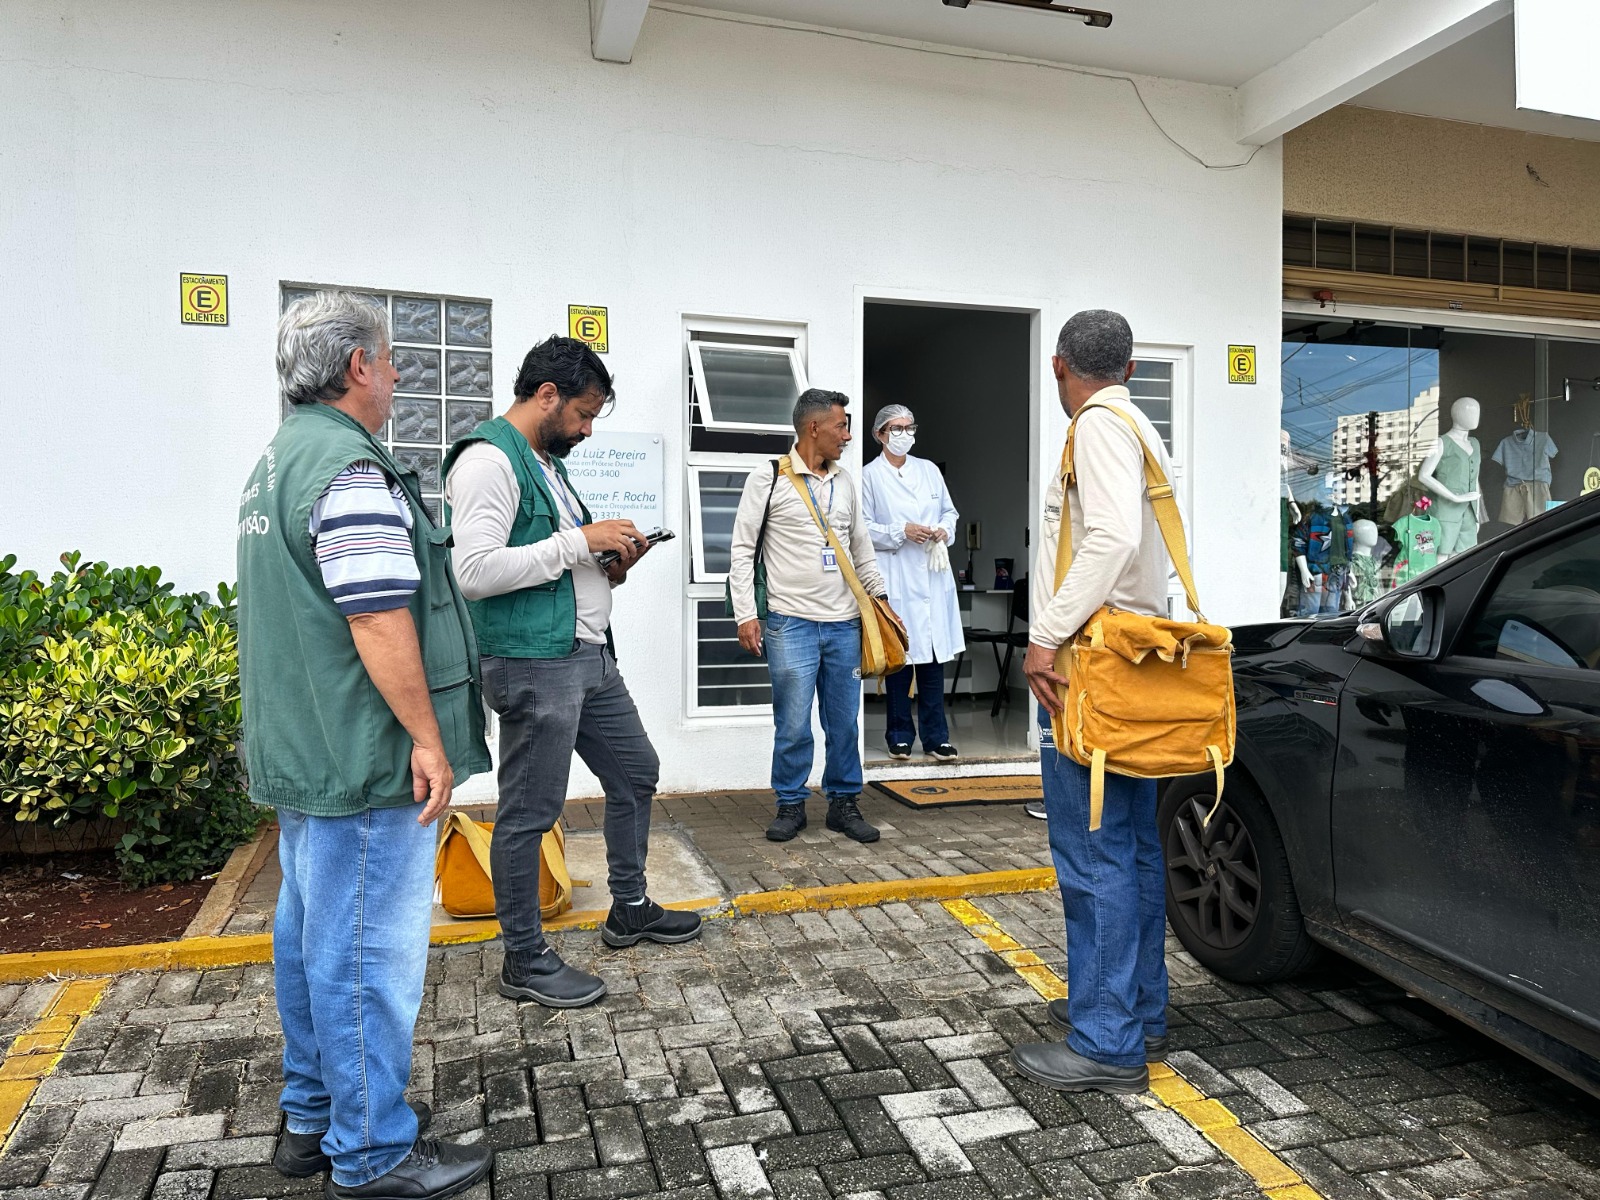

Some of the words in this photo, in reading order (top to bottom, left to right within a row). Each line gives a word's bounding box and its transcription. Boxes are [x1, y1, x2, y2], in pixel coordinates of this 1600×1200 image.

[183, 277, 225, 285] ESTACIONAMENTO
[197, 291, 212, 308] E
[185, 312, 224, 322] CLIENTES
[582, 321, 595, 337] E
[588, 342, 605, 350] NTES
[1238, 358, 1246, 371] E
[583, 448, 605, 458] Luiz
[608, 450, 646, 460] Pereira
[568, 469, 597, 477] RO/GO
[579, 490, 608, 501] hiane
[612, 492, 619, 501] F.
[624, 492, 656, 501] Rocha
